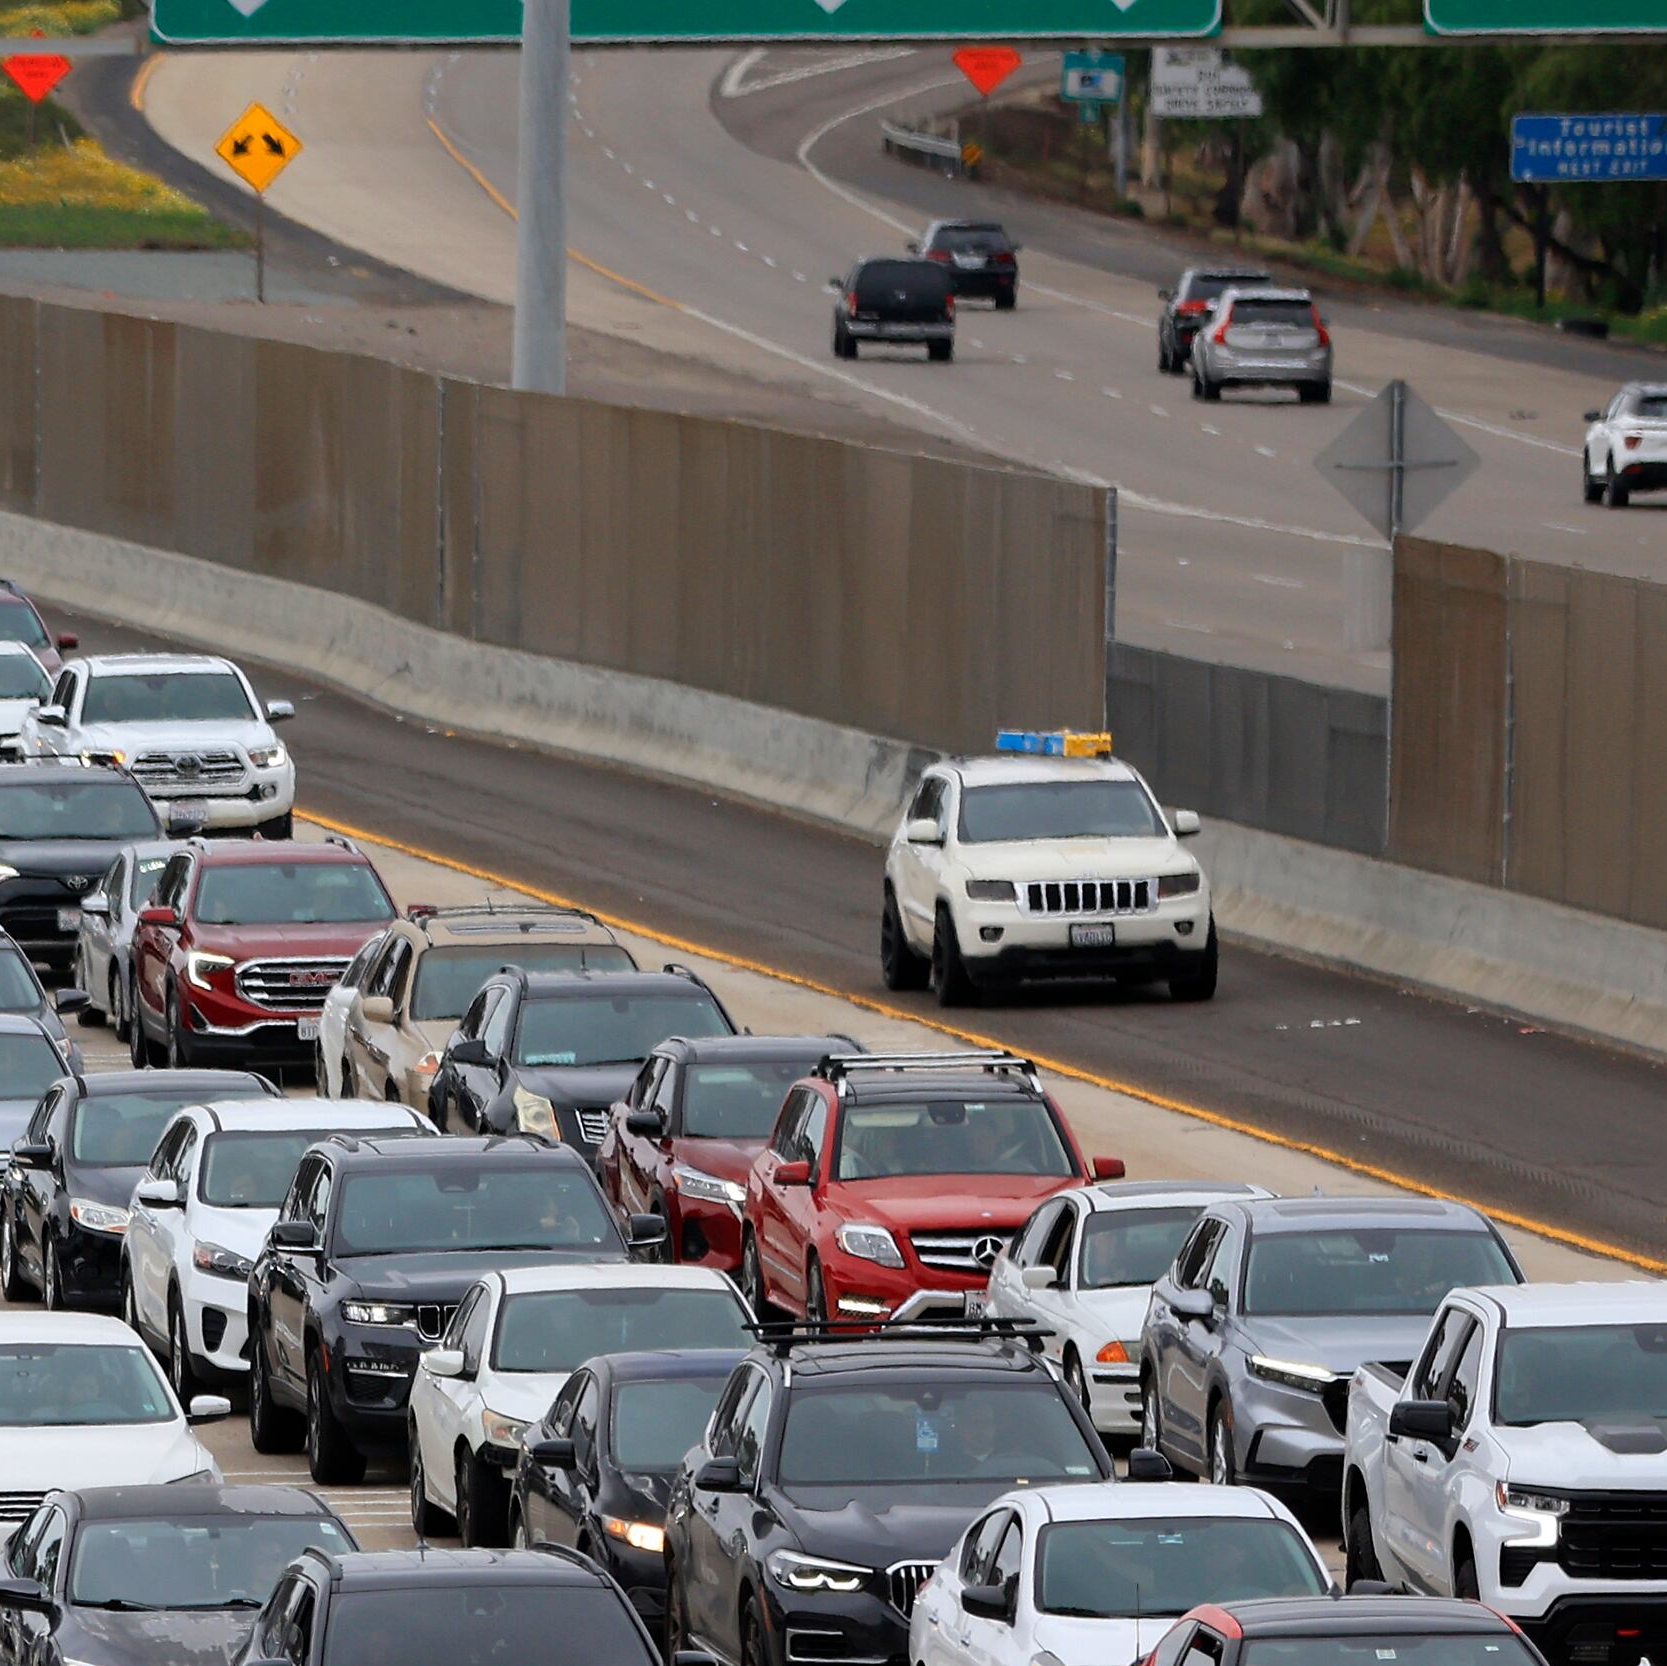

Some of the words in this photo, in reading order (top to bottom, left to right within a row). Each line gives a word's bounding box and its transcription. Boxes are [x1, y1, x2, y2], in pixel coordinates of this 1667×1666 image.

[1559, 118, 1649, 137] Tourist
[1527, 138, 1667, 156] Informatio
[1557, 159, 1600, 175] NEXT
[1609, 159, 1647, 174] EXIT
[289, 971, 340, 986] GMC
